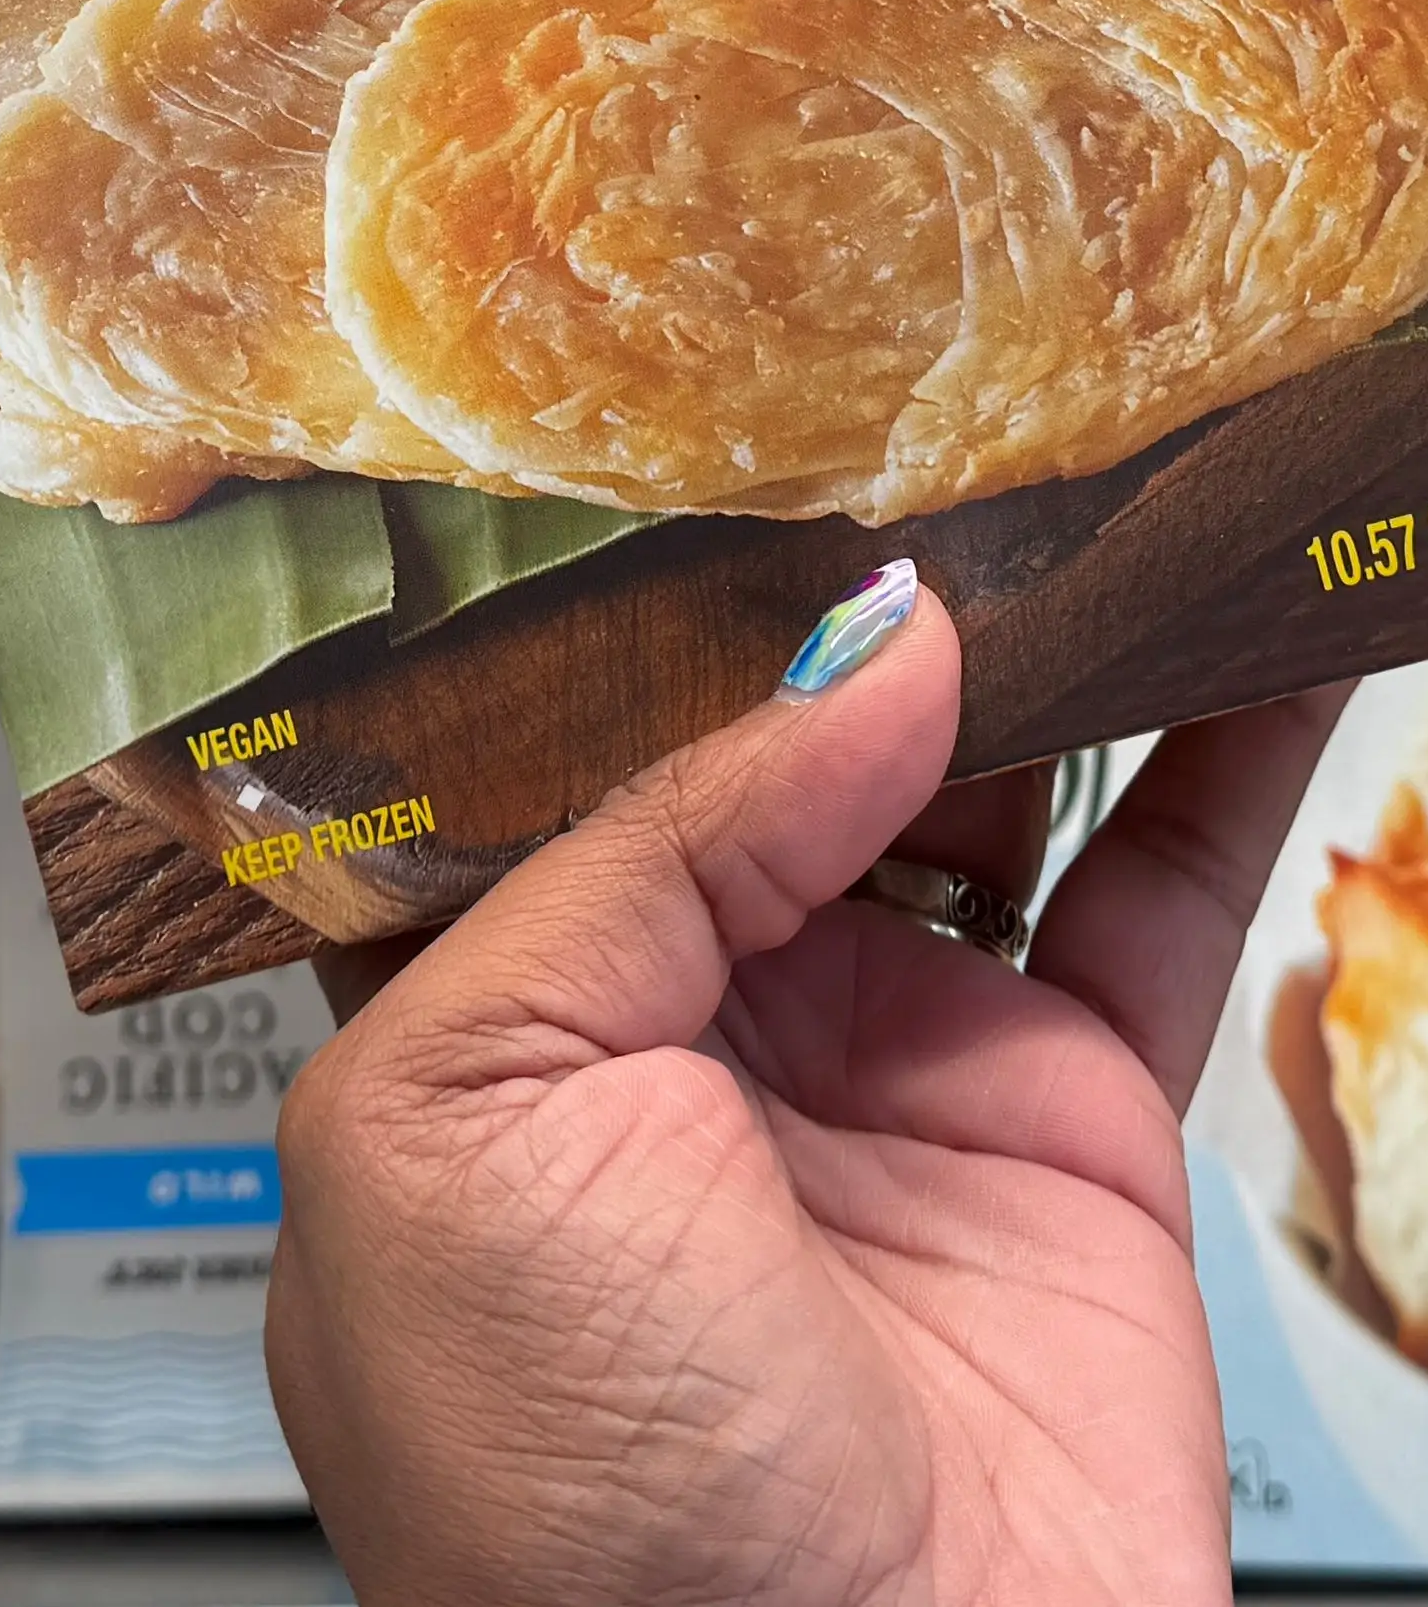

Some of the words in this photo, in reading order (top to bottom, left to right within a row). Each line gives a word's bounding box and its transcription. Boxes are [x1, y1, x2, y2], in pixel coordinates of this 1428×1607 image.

[1306, 514, 1416, 591] 10.57
[186, 709, 298, 771] VEGAN
[221, 831, 303, 888] KEEP
[309, 794, 436, 865] FROZEN
[55, 1044, 304, 1117] ACIFIC
